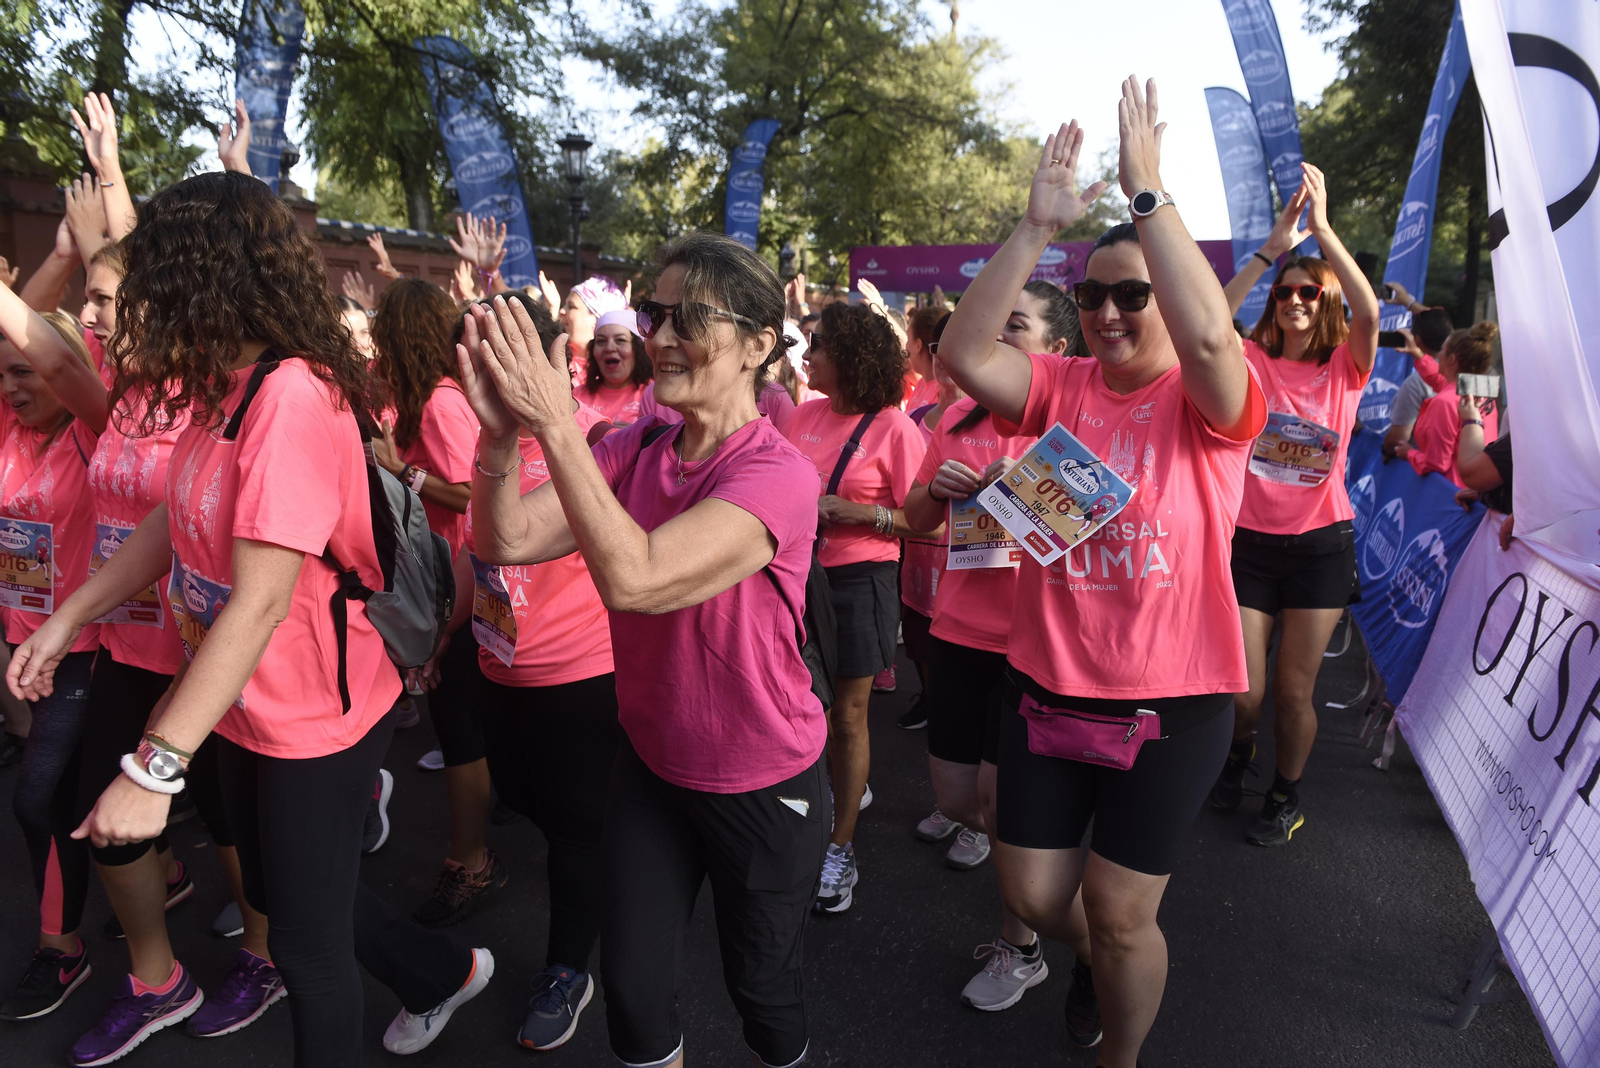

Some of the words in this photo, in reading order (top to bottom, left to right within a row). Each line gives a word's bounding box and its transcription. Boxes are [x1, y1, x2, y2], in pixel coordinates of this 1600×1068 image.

[906, 266, 940, 275] OYSHO
[1283, 426, 1315, 438] ASTURIANA
[962, 436, 997, 450] OYSHO
[1047, 440, 1063, 456] SUMA
[1278, 441, 1312, 458] 016
[1060, 462, 1095, 494] ASTURIANA
[1036, 478, 1076, 514] 016
[988, 495, 1013, 520] OYSHO
[1009, 494, 1028, 513] CARRERA
[1026, 510, 1033, 518] DE
[1032, 515, 1038, 524] LA
[1036, 520, 1054, 537] MUJER
[1030, 500, 1050, 516] 1947
[977, 513, 999, 530] 01
[986, 532, 1006, 540] 1946
[966, 542, 988, 550] CARRERA
[955, 554, 984, 564] OYSHO
[1056, 542, 1171, 579] UMA
[1156, 580, 1173, 589] 2022
[488, 593, 506, 618] 016
